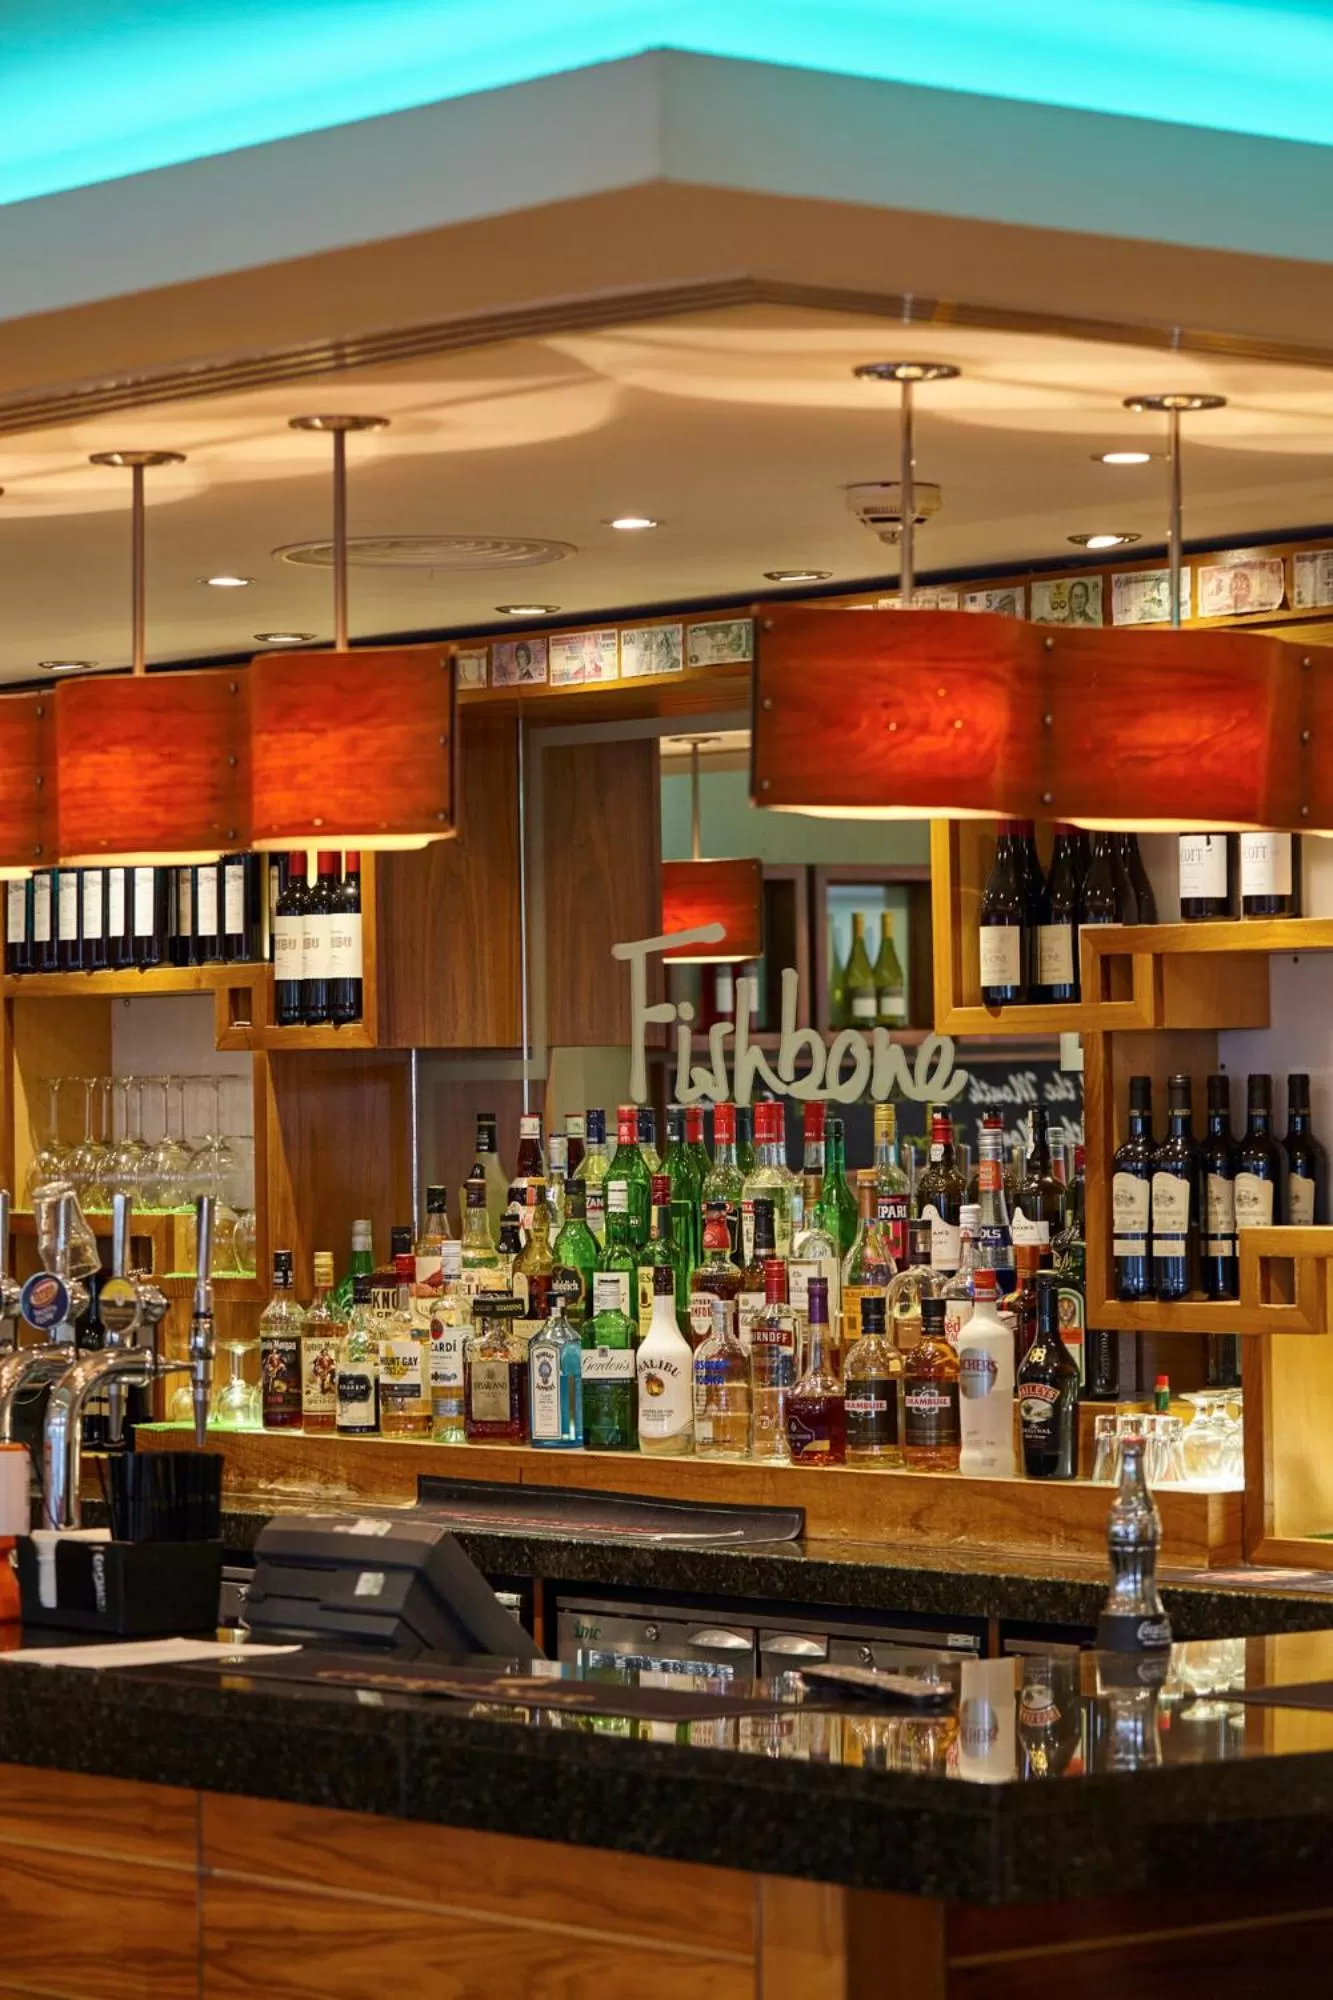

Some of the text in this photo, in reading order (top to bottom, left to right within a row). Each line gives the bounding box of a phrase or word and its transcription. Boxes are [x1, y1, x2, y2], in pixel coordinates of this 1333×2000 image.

[611, 922, 969, 1104] Fishbone
[582, 1354, 630, 1371] Gordon's
[637, 1358, 682, 1378] MALIBU
